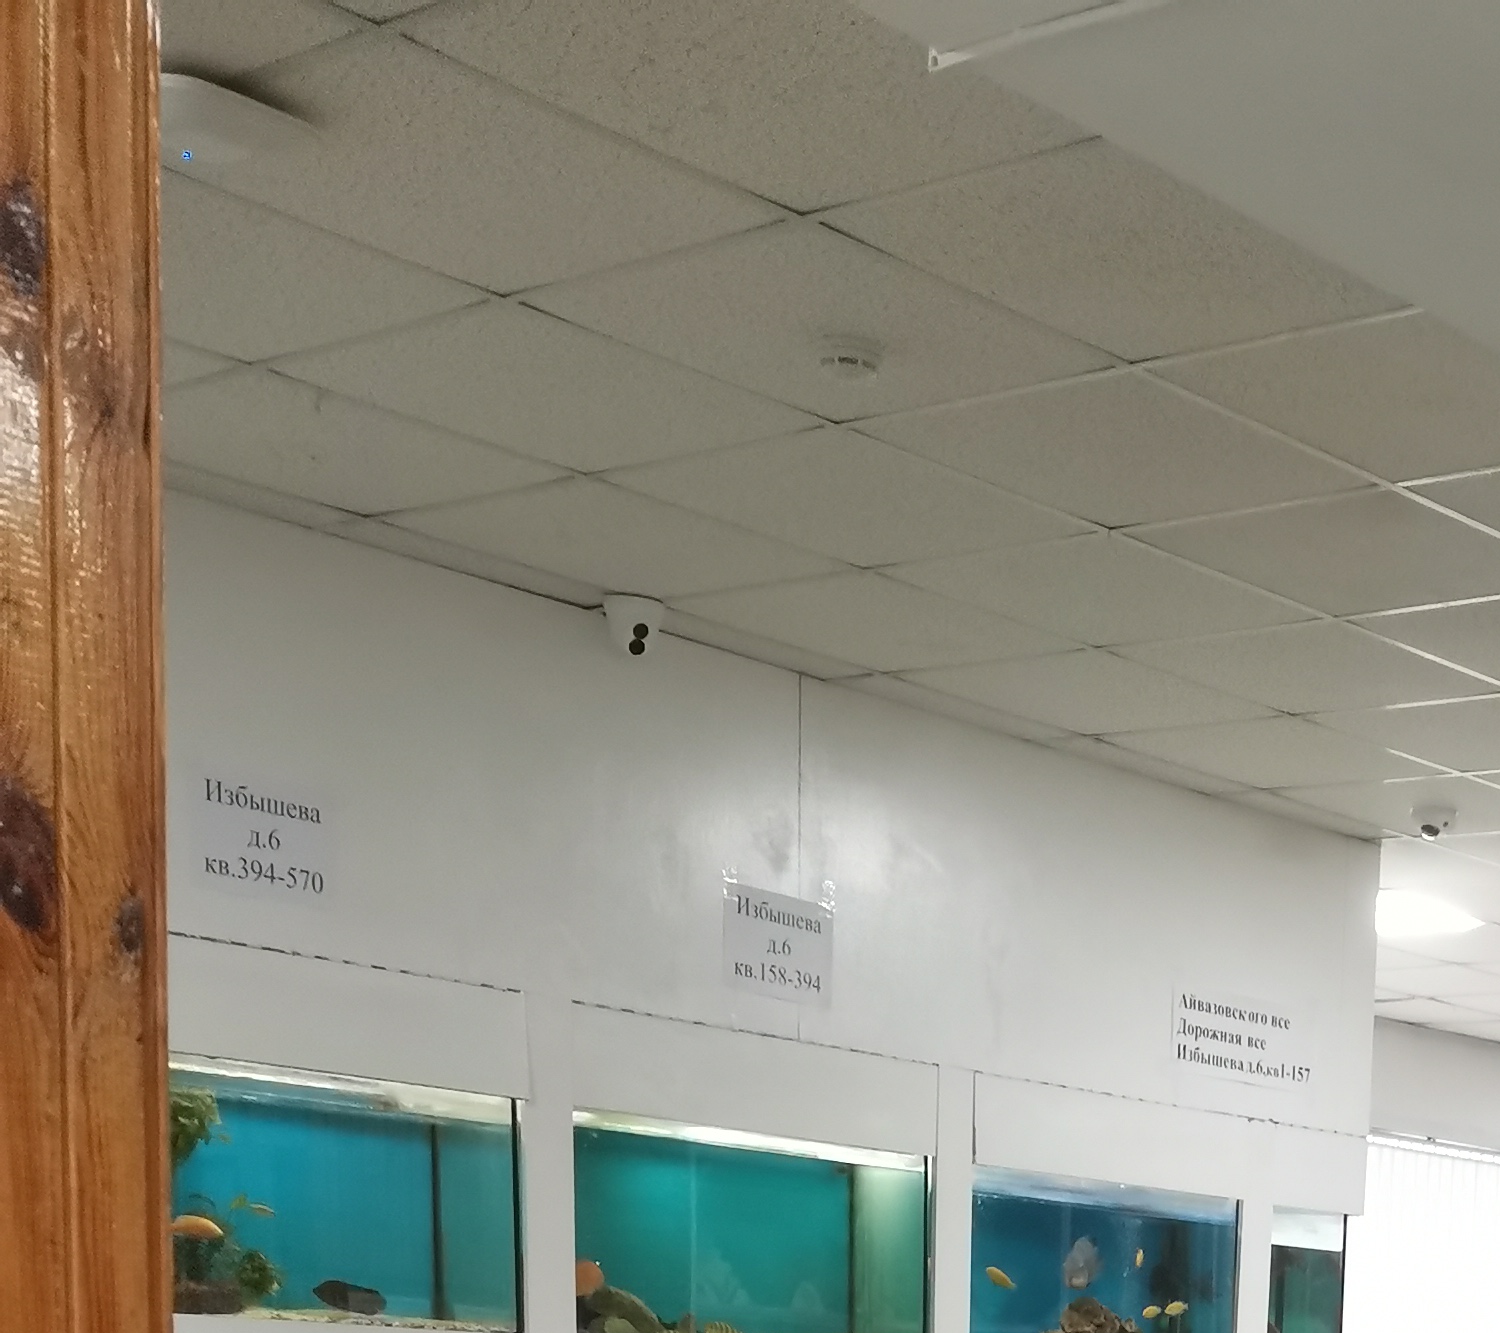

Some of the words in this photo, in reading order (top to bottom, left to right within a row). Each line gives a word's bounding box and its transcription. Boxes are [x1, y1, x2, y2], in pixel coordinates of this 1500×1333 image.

[204, 777, 322, 824] Избышева
[246, 828, 281, 851] д.6
[204, 856, 324, 894] кв.394-570
[736, 894, 822, 934] Избышева
[766, 938, 792, 956] д.6
[734, 961, 822, 993] кв.158-394
[1178, 993, 1268, 1025] Айвазовского
[1270, 1015, 1291, 1031] все
[1176, 1017, 1242, 1046] Дорожная
[1247, 1035, 1267, 1051] все
[1176, 1043, 1245, 1072] Избышева
